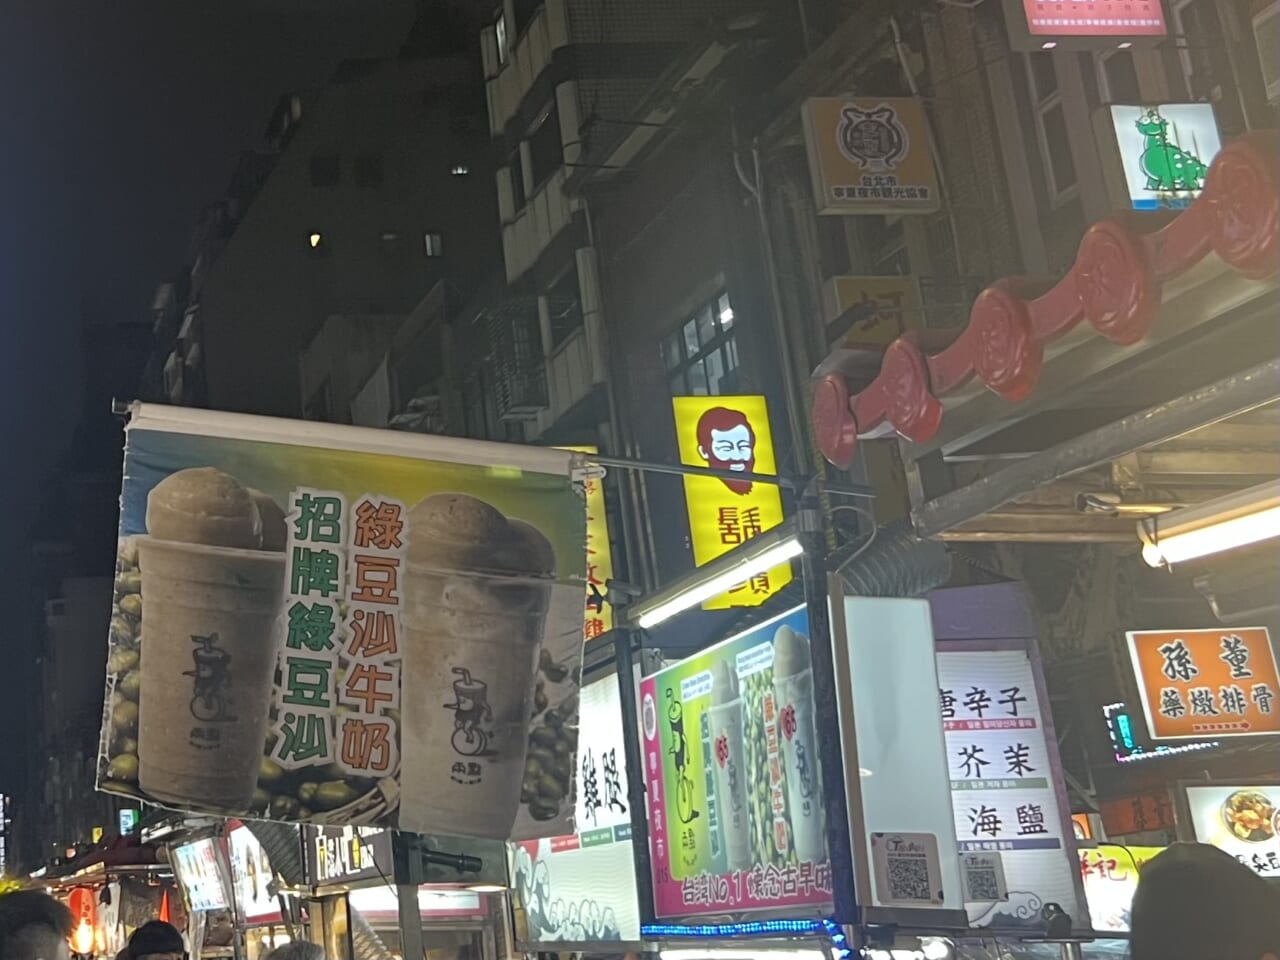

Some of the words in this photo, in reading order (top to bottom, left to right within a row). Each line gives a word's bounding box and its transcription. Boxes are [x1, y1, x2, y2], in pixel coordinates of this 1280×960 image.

[862, 175, 897, 188] 台北市
[280, 493, 342, 762] 招牌綠豆沙
[341, 500, 404, 771] 綠豆沙牛奶
[1158, 636, 1253, 681] 孫董
[1159, 684, 1275, 718] 藥燉排骨
[967, 803, 1049, 838] 海鹽
